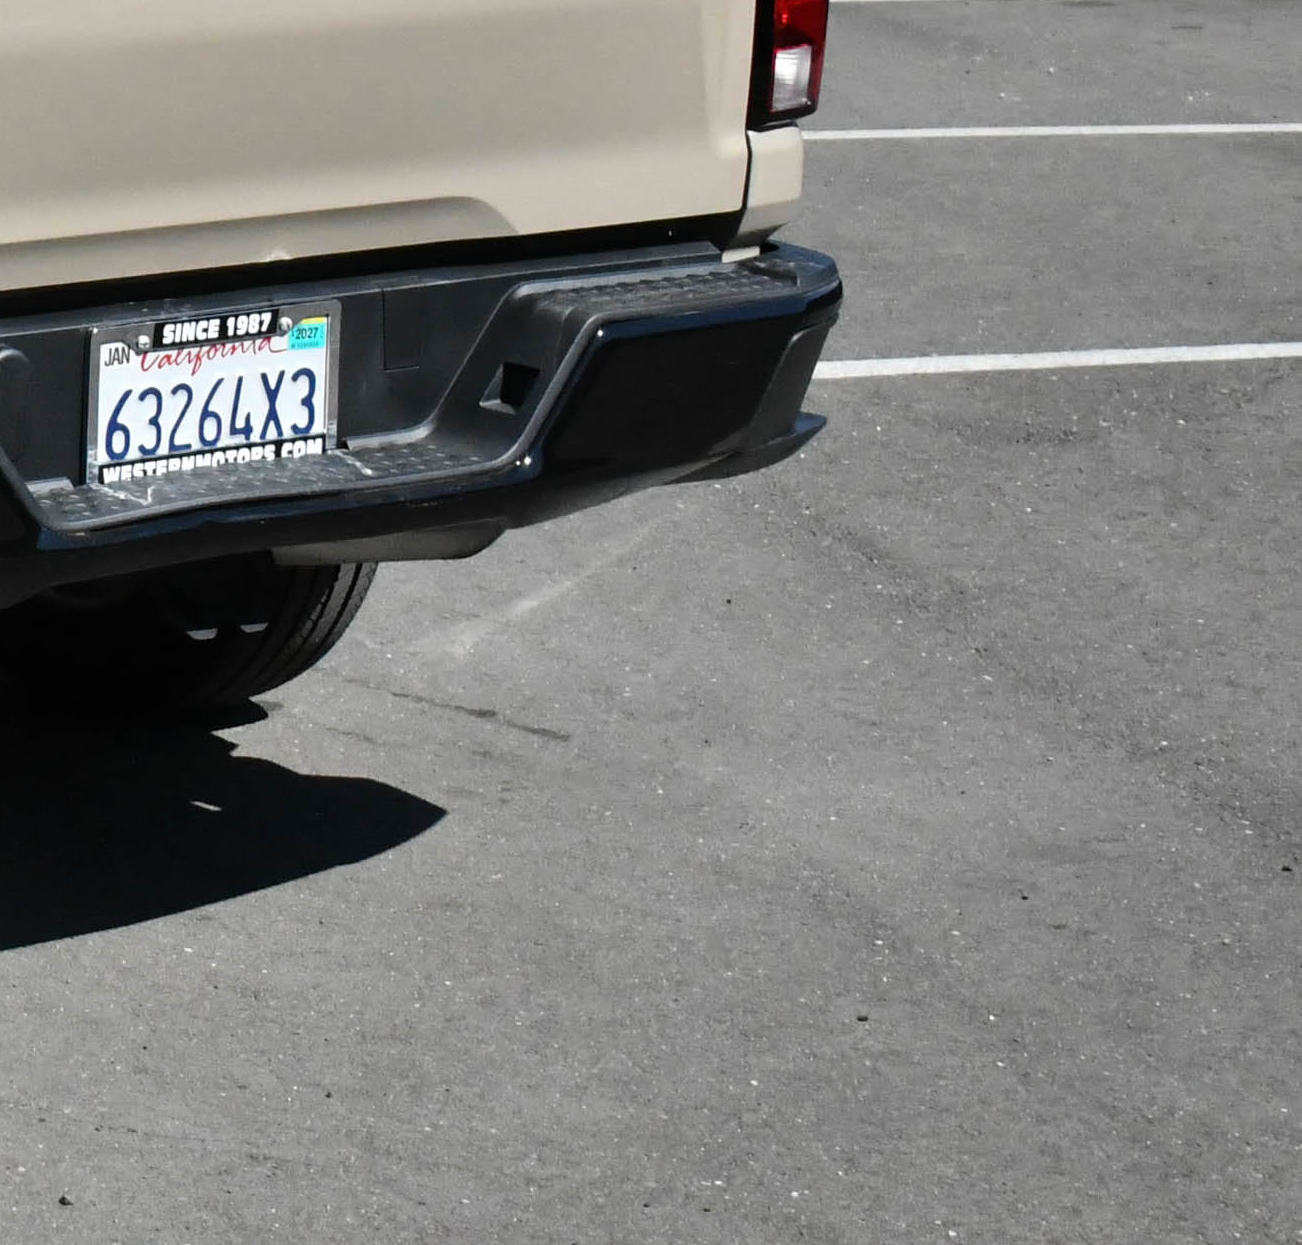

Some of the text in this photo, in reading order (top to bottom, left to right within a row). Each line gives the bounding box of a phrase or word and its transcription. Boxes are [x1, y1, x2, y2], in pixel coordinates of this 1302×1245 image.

[162, 312, 273, 345] SINCE 1987
[295, 326, 319, 340] 2027
[104, 347, 131, 367] JAN
[140, 335, 285, 377] California
[105, 367, 317, 461] 63264X3
[102, 438, 324, 484] WESTERNMOTORSCOM
